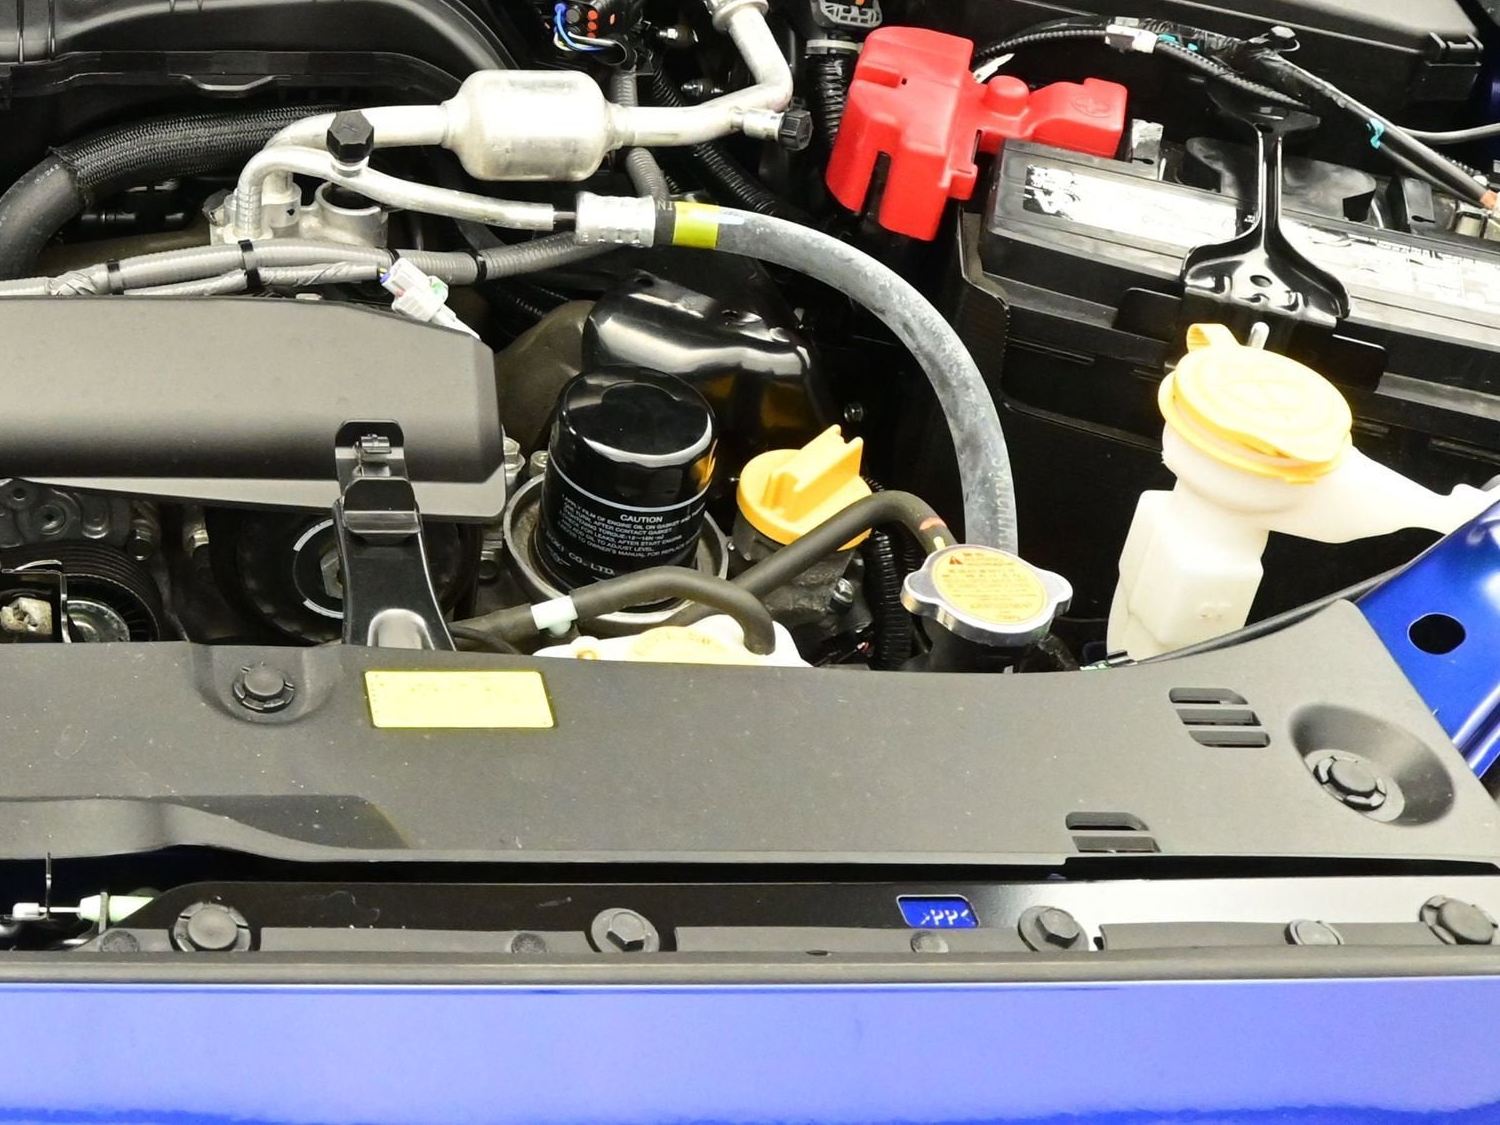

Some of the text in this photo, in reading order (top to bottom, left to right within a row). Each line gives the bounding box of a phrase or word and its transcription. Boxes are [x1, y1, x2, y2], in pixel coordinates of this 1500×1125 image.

[597, 515, 605, 523] OF
[607, 519, 631, 528] ENGINE
[620, 514, 663, 522] CAUTION
[594, 520, 613, 530] AFTER
[615, 527, 646, 535] CONTACT
[587, 540, 616, 554] OWNER'S
[607, 542, 632, 551] ADJUST
[618, 539, 639, 547] AFTER
